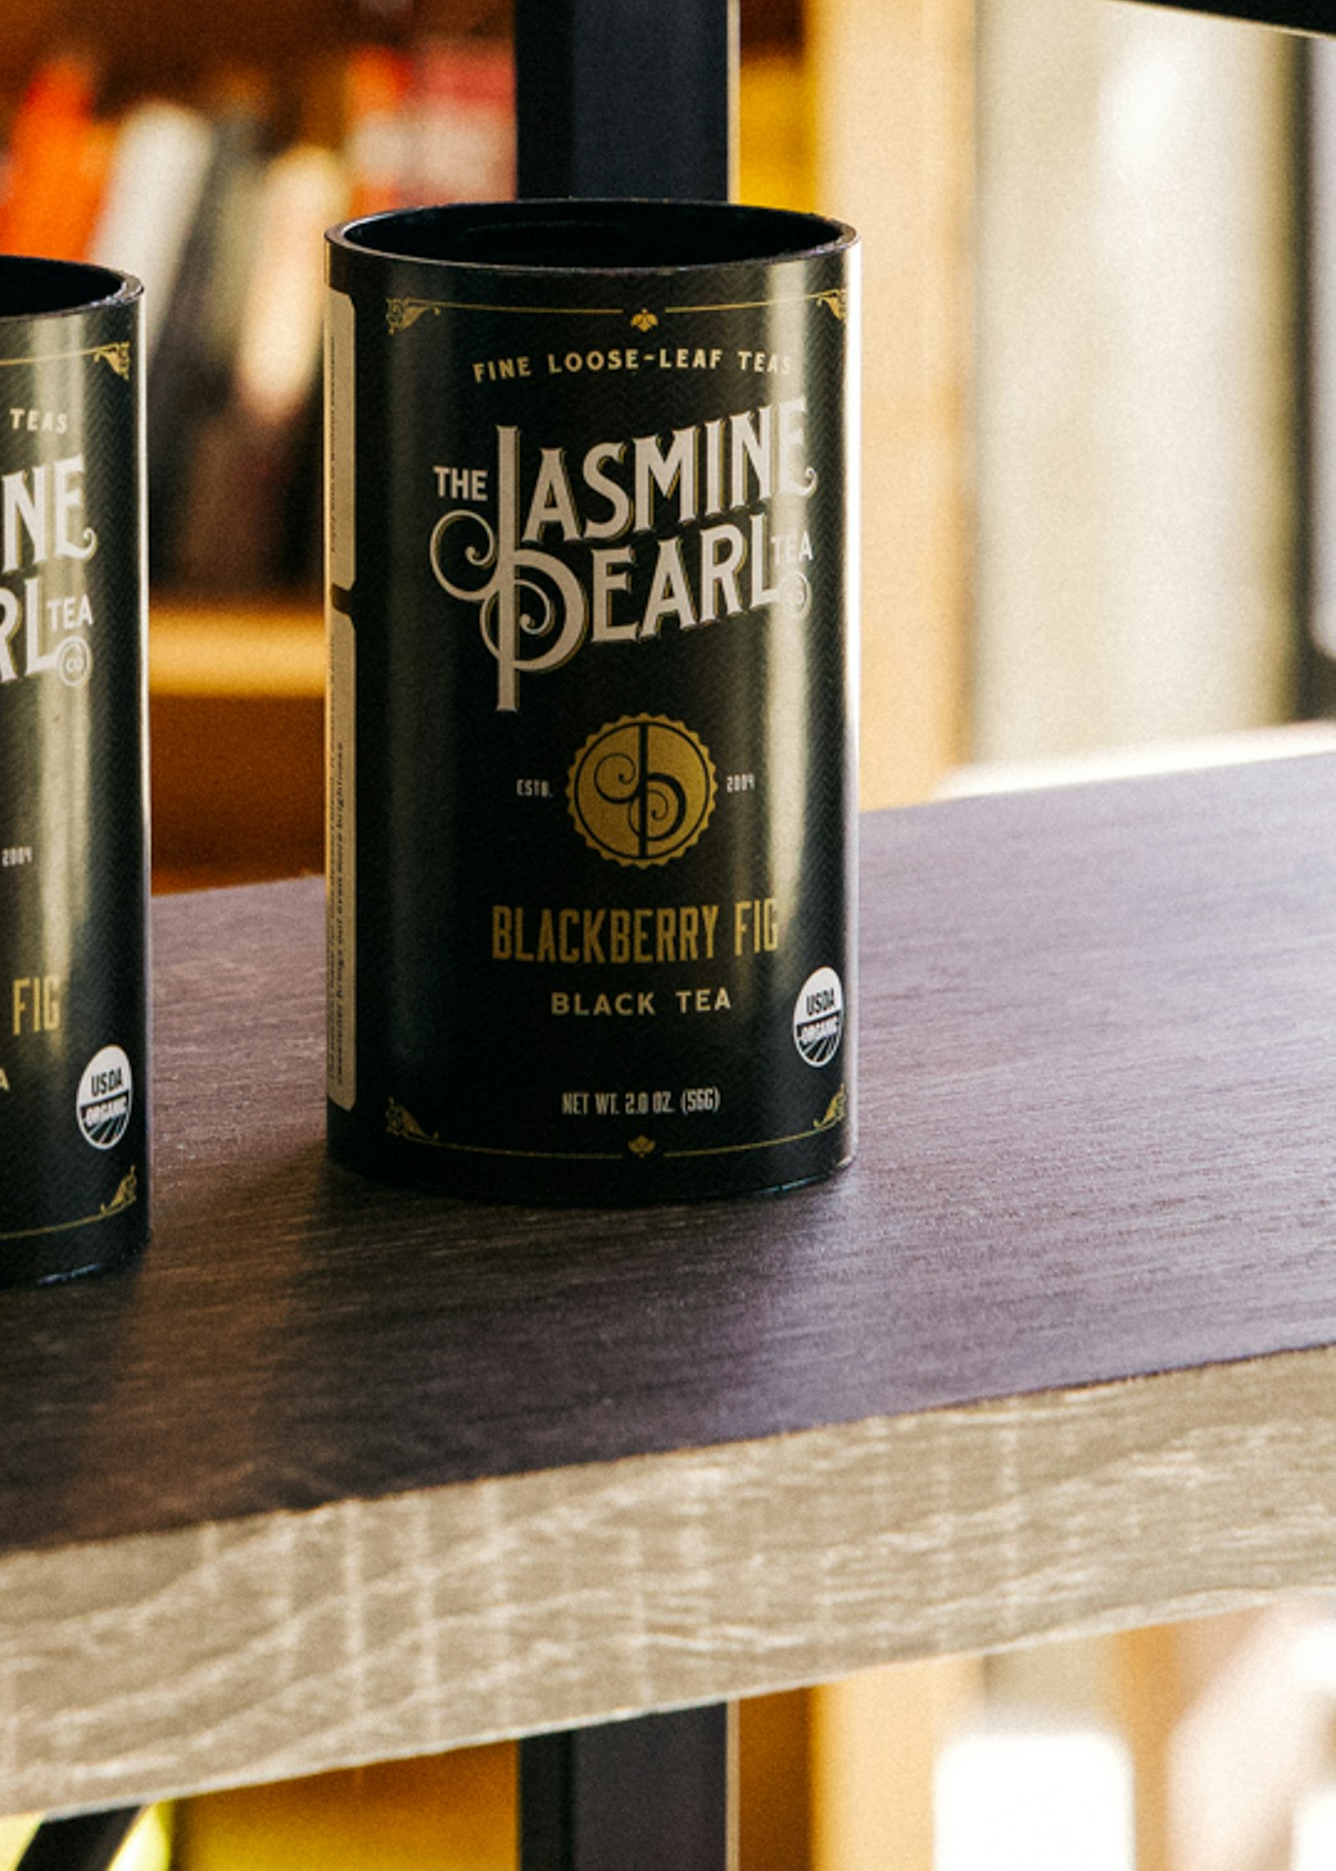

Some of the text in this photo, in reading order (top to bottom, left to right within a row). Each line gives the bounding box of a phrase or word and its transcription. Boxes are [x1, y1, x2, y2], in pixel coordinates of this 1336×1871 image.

[472, 348, 792, 383] FINE LOOSE-LEAF TEAS
[10, 407, 69, 435] TEAS
[430, 397, 818, 600] JASMINE
[432, 465, 488, 501] THE
[47, 595, 93, 633] TEA
[480, 512, 780, 712] PEARL
[770, 530, 813, 563] TEA
[726, 773, 755, 793] 2004
[1, 846, 32, 866] 2004
[491, 897, 781, 965] BLACKBERRY FIG
[12, 974, 64, 1034] FIG
[550, 987, 732, 1018] BLACK TEA
[806, 987, 836, 1018] USDA
[90, 1067, 124, 1096] USDA
[561, 1092, 589, 1115] NET
[594, 1092, 620, 1115] WT.
[625, 1091, 649, 1115] 2.0
